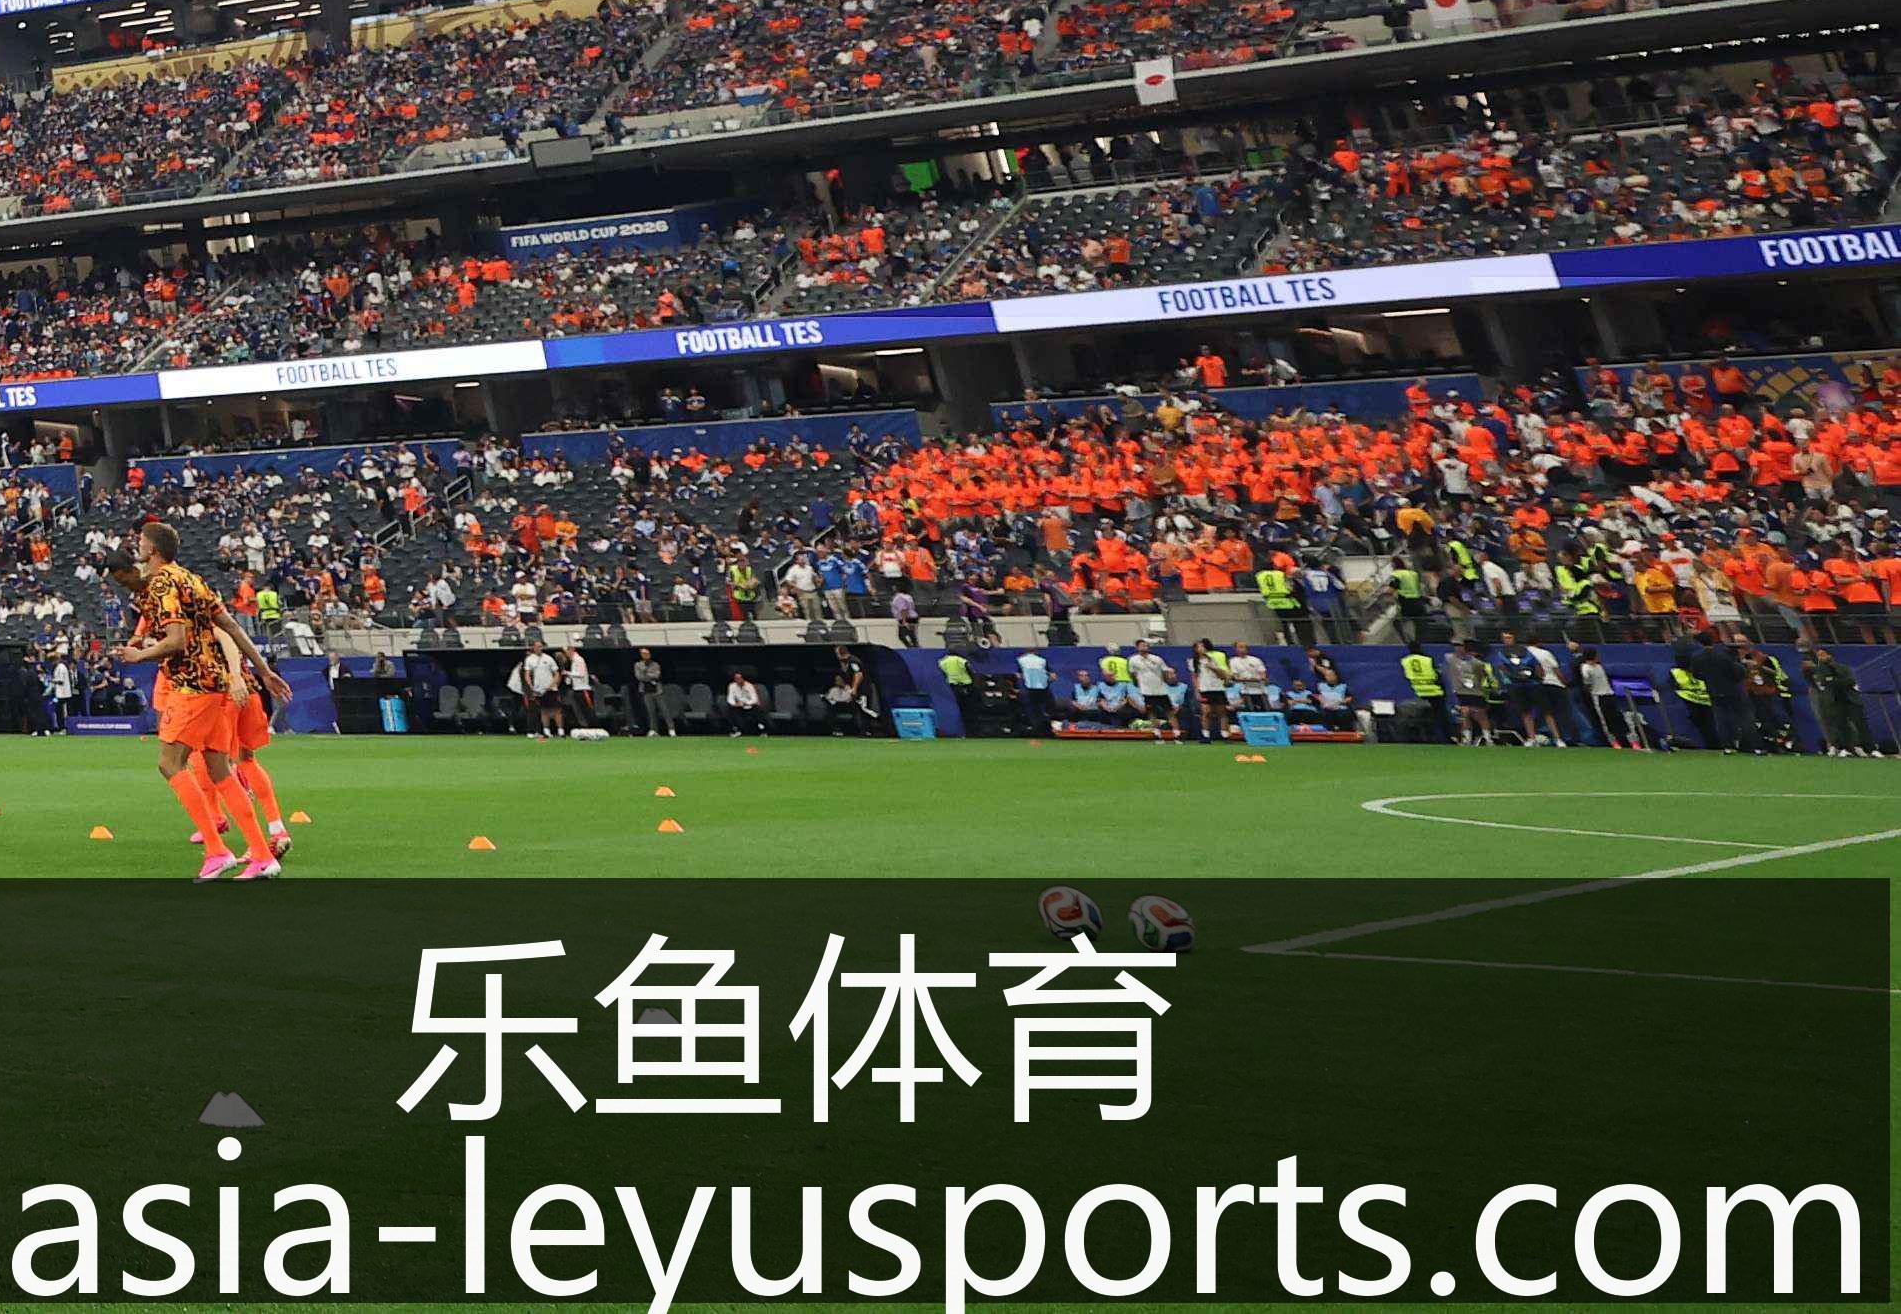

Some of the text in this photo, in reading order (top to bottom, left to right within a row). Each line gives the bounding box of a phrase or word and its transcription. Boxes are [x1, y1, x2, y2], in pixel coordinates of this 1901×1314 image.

[510, 220, 670, 248] FIFA WORLD CUP 2026
[1759, 230, 1901, 267] FOOTBAL
[1158, 283, 1284, 313] FOOTBALL
[678, 328, 781, 354] FOOTBALL
[277, 361, 359, 384] FOOTBALL
